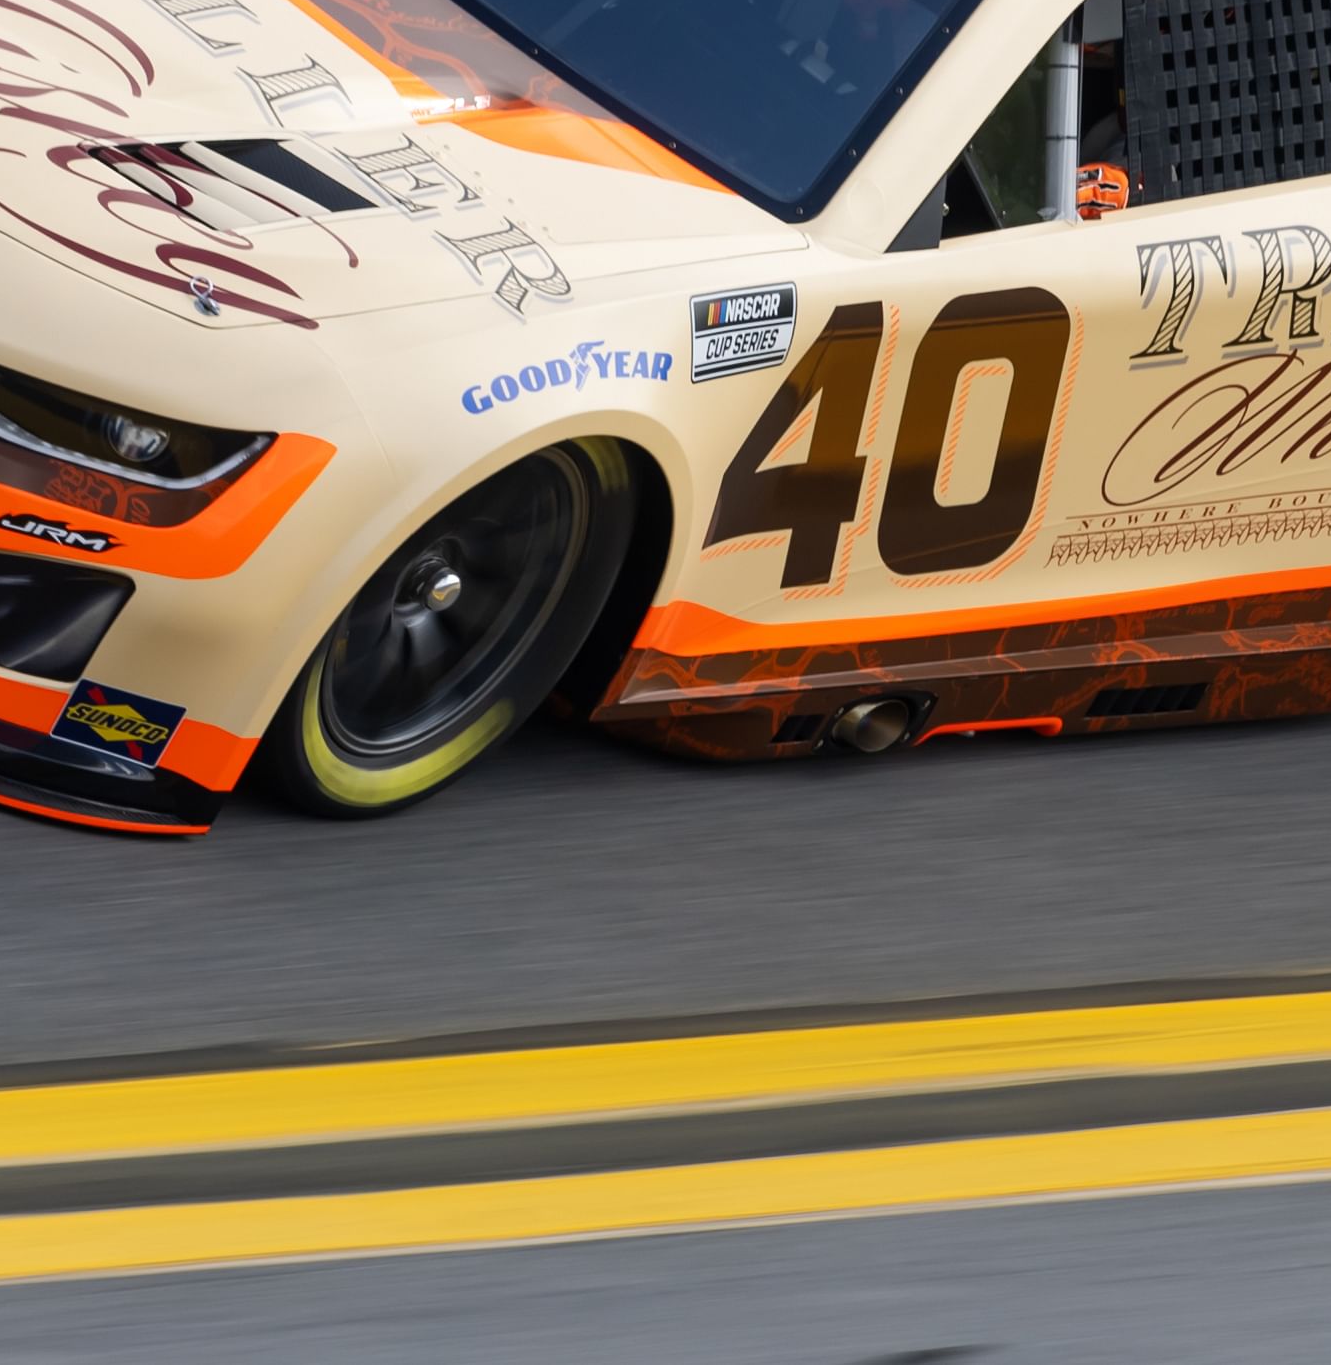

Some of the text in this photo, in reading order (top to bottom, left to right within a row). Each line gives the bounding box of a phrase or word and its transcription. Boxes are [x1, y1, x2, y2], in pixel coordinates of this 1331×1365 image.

[724, 292, 781, 323] NASCAR
[706, 328, 780, 360] CUP SERIES
[702, 286, 1076, 593] 40
[1078, 501, 1242, 532] NOWHERE
[0, 517, 108, 553] JRM
[67, 700, 170, 746] SUNOCO
